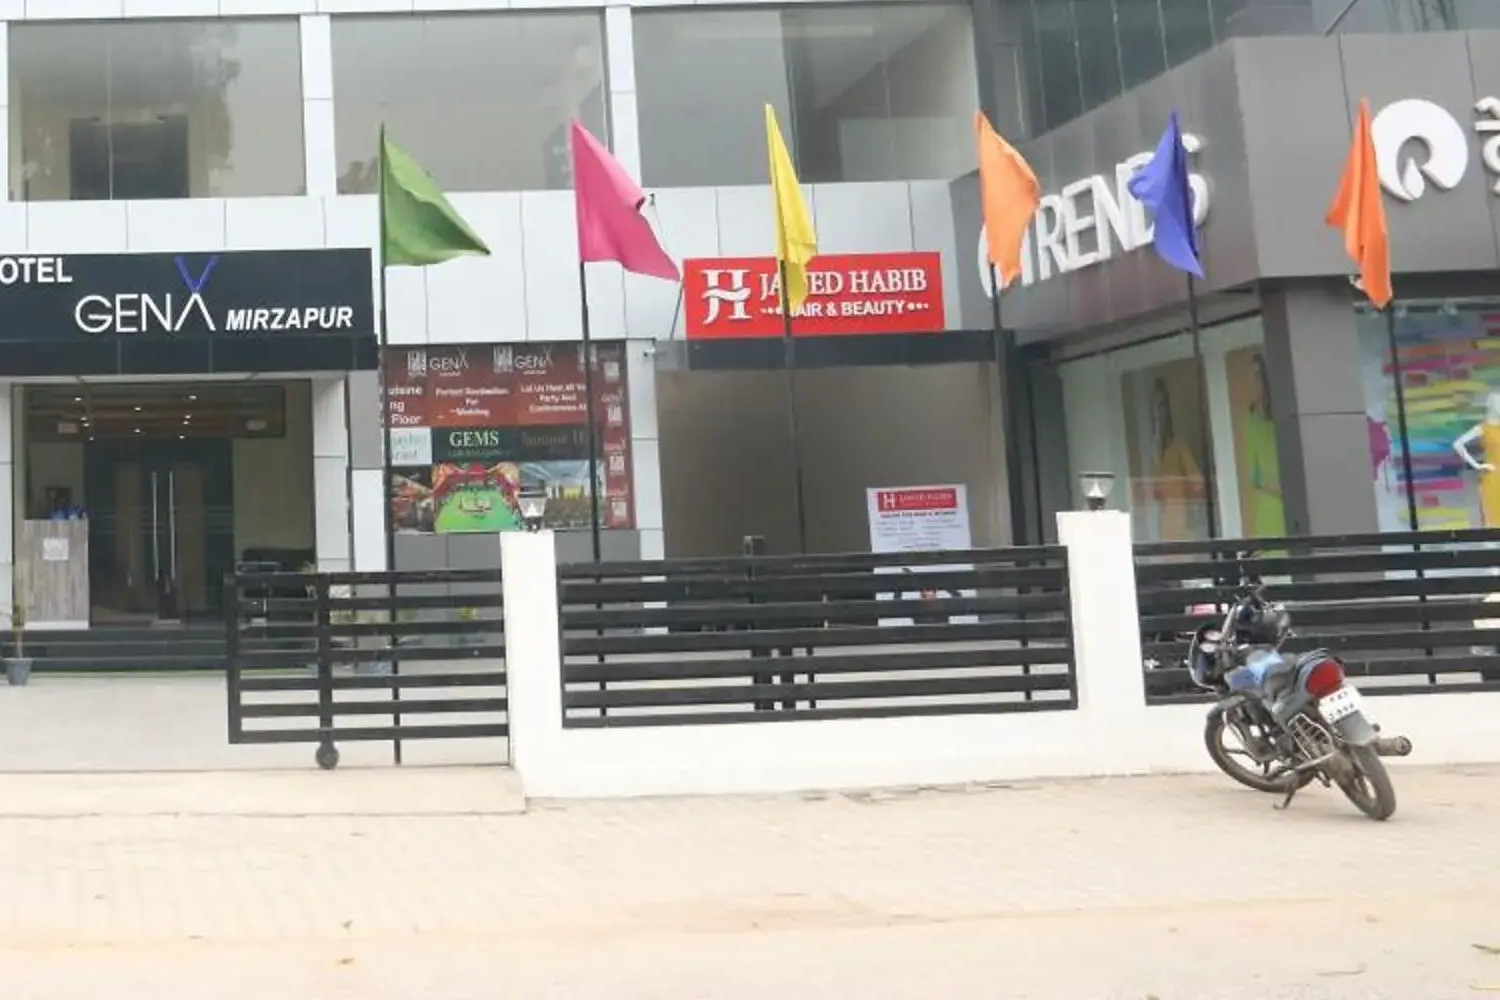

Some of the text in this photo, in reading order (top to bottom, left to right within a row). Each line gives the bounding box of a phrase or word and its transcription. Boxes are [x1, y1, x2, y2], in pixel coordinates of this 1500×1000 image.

[75, 255, 353, 333] GENX MIRZAPUR
[760, 268, 927, 301] JAED HABIB
[788, 299, 906, 318] AIR & BEAUTY
[449, 430, 501, 447] GEMS
